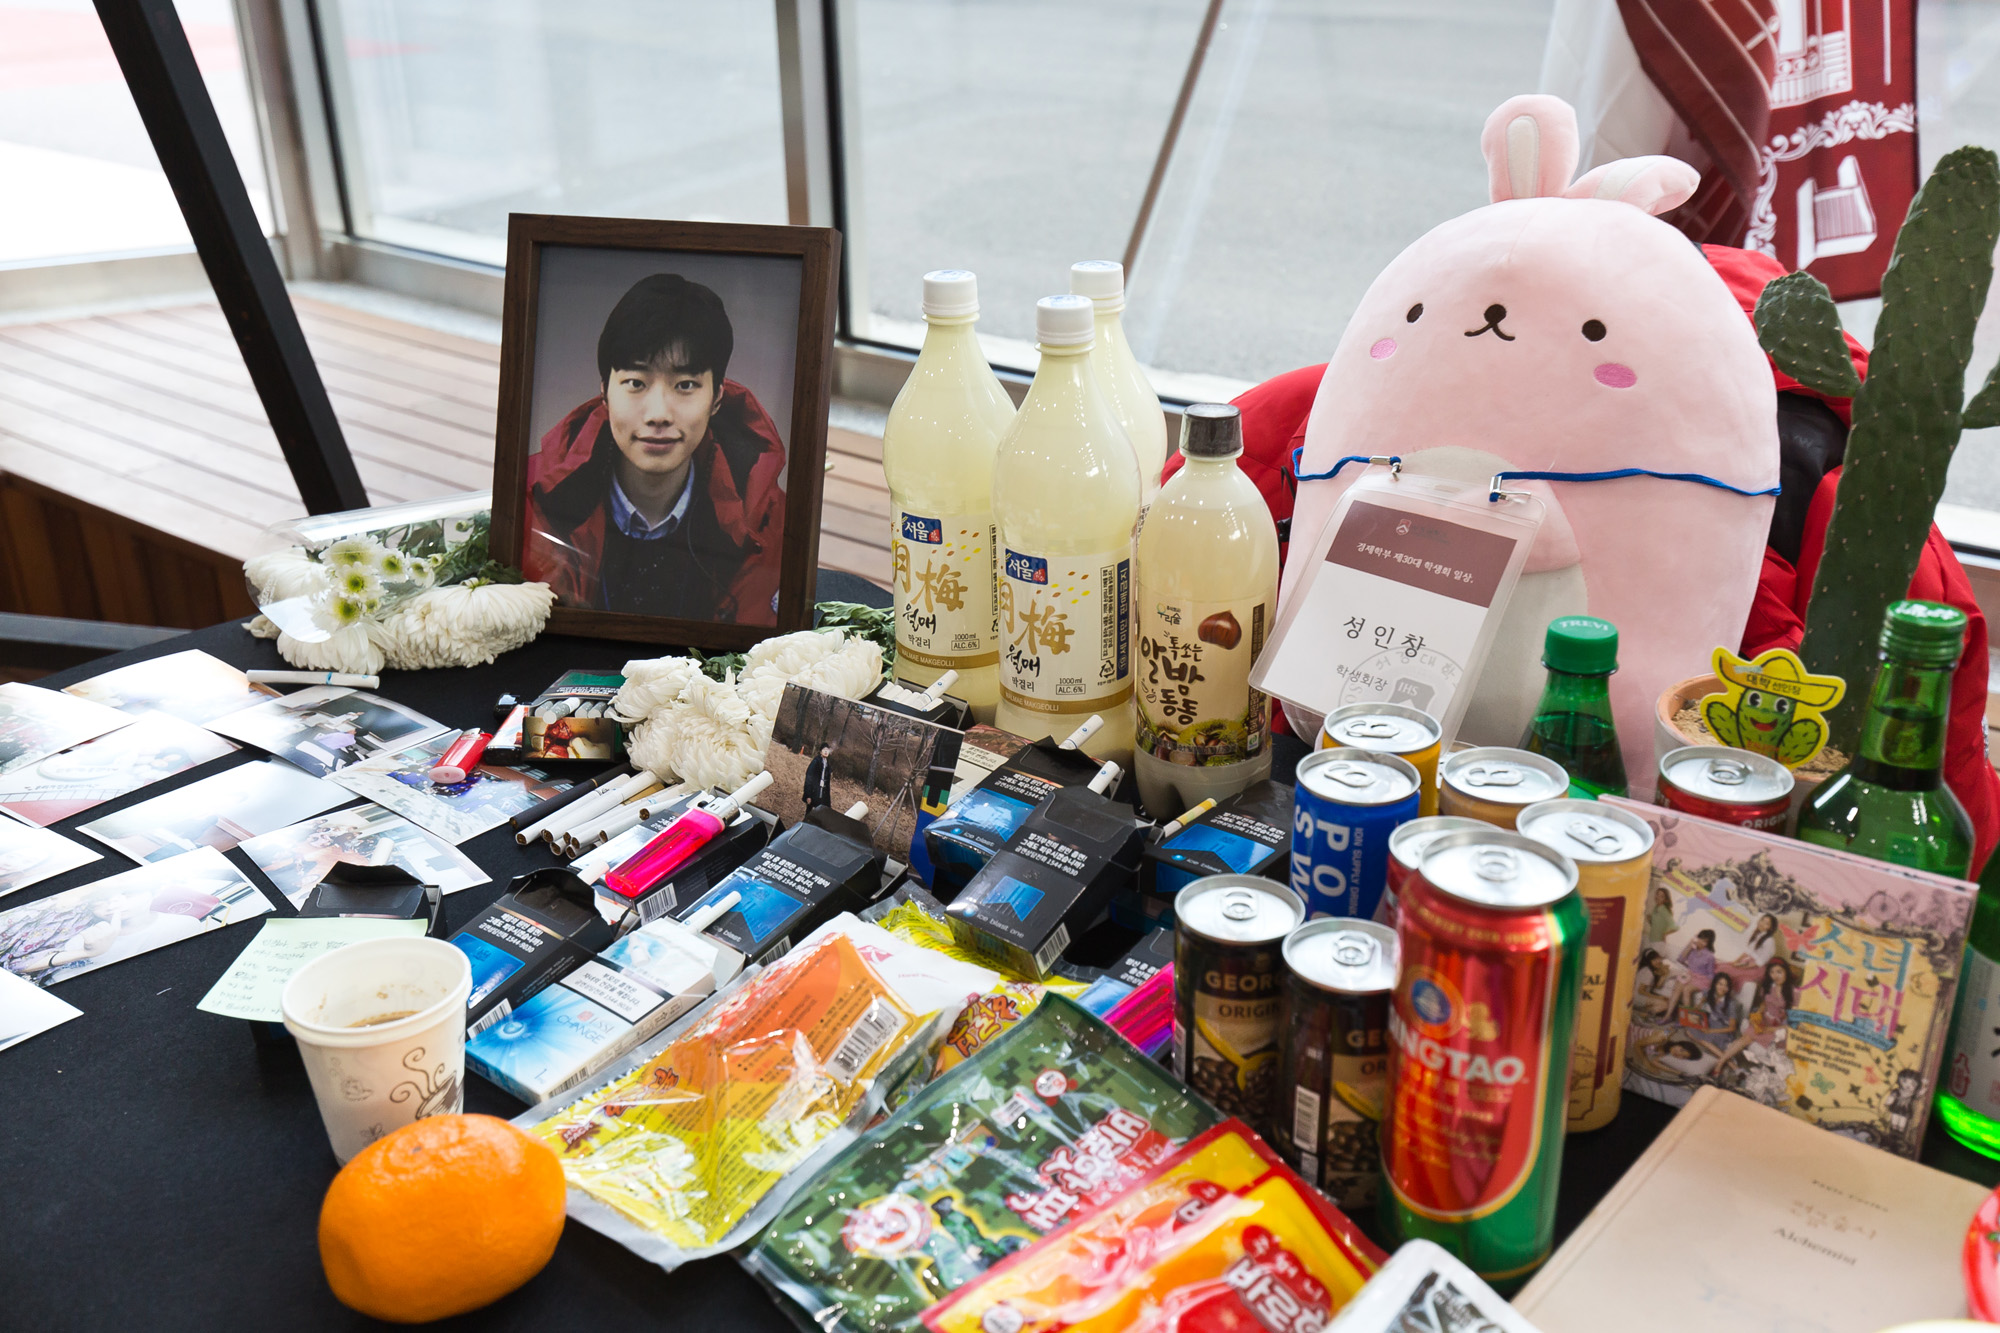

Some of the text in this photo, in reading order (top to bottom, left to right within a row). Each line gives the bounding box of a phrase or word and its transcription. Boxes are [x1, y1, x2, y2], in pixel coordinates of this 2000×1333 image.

[904, 520, 929, 542] 서울
[1008, 558, 1033, 580] 서울
[1356, 541, 1474, 584] 경제학부 제30대 학생회 일상.
[903, 603, 937, 635] 월매
[908, 634, 931, 650] 막걸리
[920, 656, 955, 667] MAKGEOLLI
[1005, 644, 1041, 677] 월매
[1141, 636, 1206, 696] 알밤
[1011, 677, 1035, 692] 막걸리
[1336, 664, 1389, 692] 학생회장
[1398, 682, 1419, 697] IHS
[1746, 673, 1771, 688] 대학
[1023, 700, 1059, 711] MAKGEOLLI
[1160, 688, 1199, 725] 동동
[1000, 775, 1018, 785] 그래도
[1210, 818, 1246, 832] 금연상담전화
[1214, 815, 1284, 840] 그래도 피우시겠습니까?
[1254, 821, 1270, 829] 원인
[1028, 832, 1088, 862] 발기부전의 원인 흡연!
[1353, 827, 1364, 847] ION
[778, 859, 797, 870] 흡연은
[1014, 845, 1079, 877] 금연상담전화 1544-9030
[1020, 838, 1085, 870] 그래도 피우시겠습니까?
[778, 867, 798, 879] 원인이
[1351, 849, 1362, 885] SUPPLY
[754, 864, 811, 895] 금연상담전화 1544-9030
[478, 922, 535, 953] 금연상담전화 1544-9030
[486, 915, 544, 947] 그래도 피우시겠습니까?
[516, 920, 531, 930] 원인
[527, 925, 544, 937] 흡연!
[722, 929, 742, 943] blast
[977, 913, 1025, 939] ice blast one
[1797, 922, 1912, 992] 소녀
[574, 979, 605, 996] 금연상담전화
[583, 972, 601, 984] 자녀의
[598, 981, 618, 993] 건강을
[603, 973, 637, 993] 부모의 흡연은
[1793, 966, 1904, 1041] 시대
[557, 1014, 606, 1045] CHANGE
[1772, 1227, 1858, 1266] Alchemist
